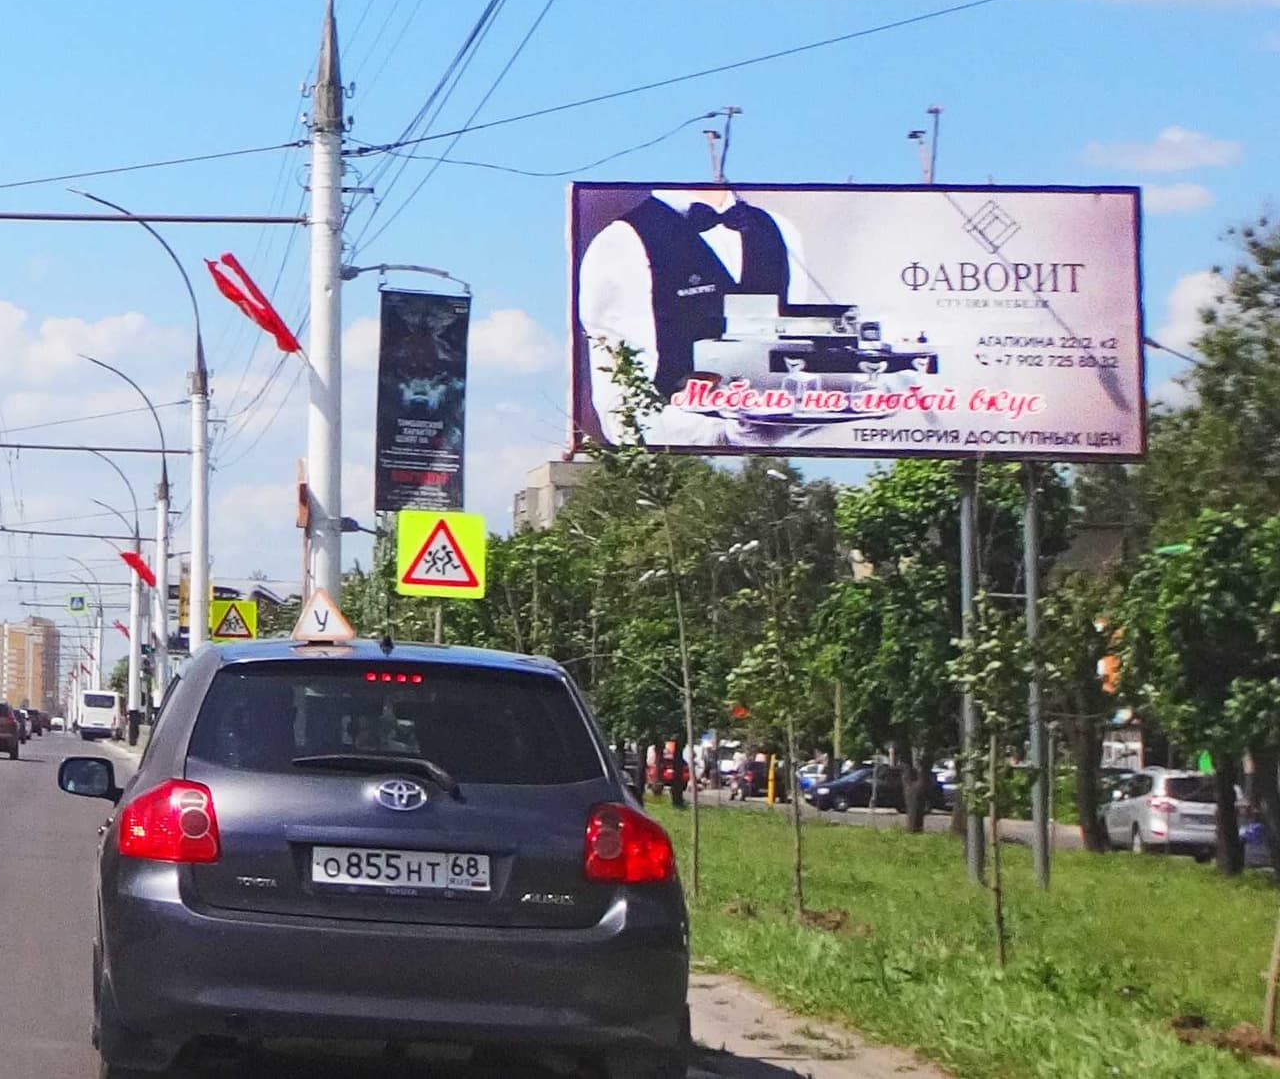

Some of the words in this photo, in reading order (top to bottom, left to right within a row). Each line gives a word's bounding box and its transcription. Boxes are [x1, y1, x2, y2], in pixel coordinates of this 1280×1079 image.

[901, 261, 1086, 293] ФАВОРИТ
[672, 378, 792, 409] Мебель
[804, 392, 847, 409] на
[854, 385, 958, 411] любой
[968, 388, 1046, 420] вкус
[853, 428, 960, 444] ТЕРРИТОРИЯ
[964, 431, 1080, 447] ДОСТУПНЫХ
[1087, 432, 1122, 447] ЦЕН
[451, 856, 479, 877] 68
